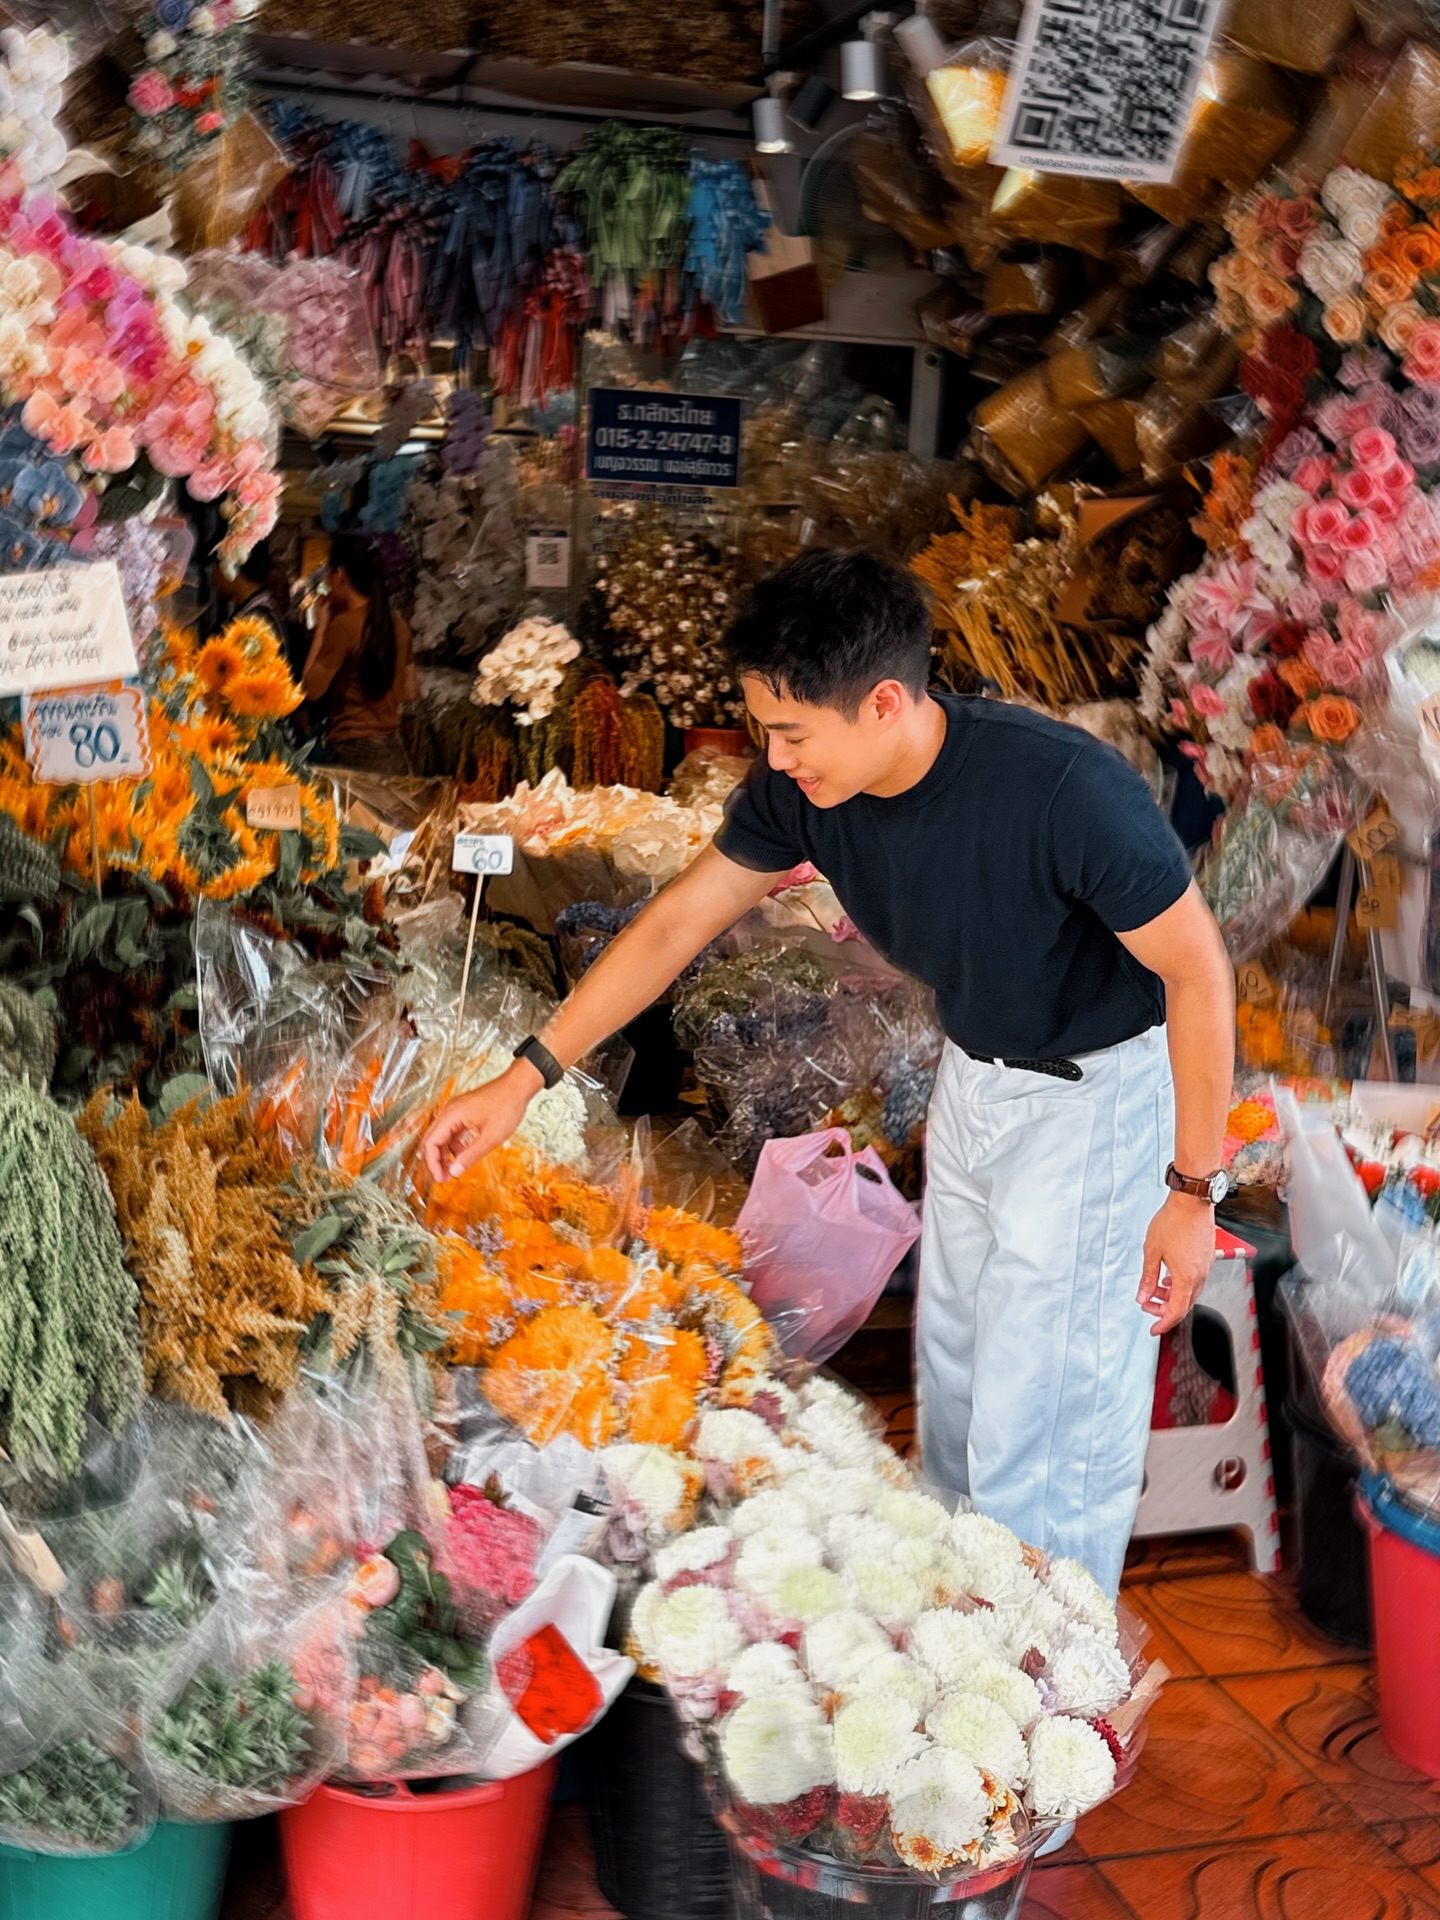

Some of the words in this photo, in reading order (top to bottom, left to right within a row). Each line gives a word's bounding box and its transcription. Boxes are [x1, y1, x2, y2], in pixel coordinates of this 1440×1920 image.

[617, 401, 716, 426] ธ.กสิกรไทย
[595, 427, 735, 455] 015-2-24747-8
